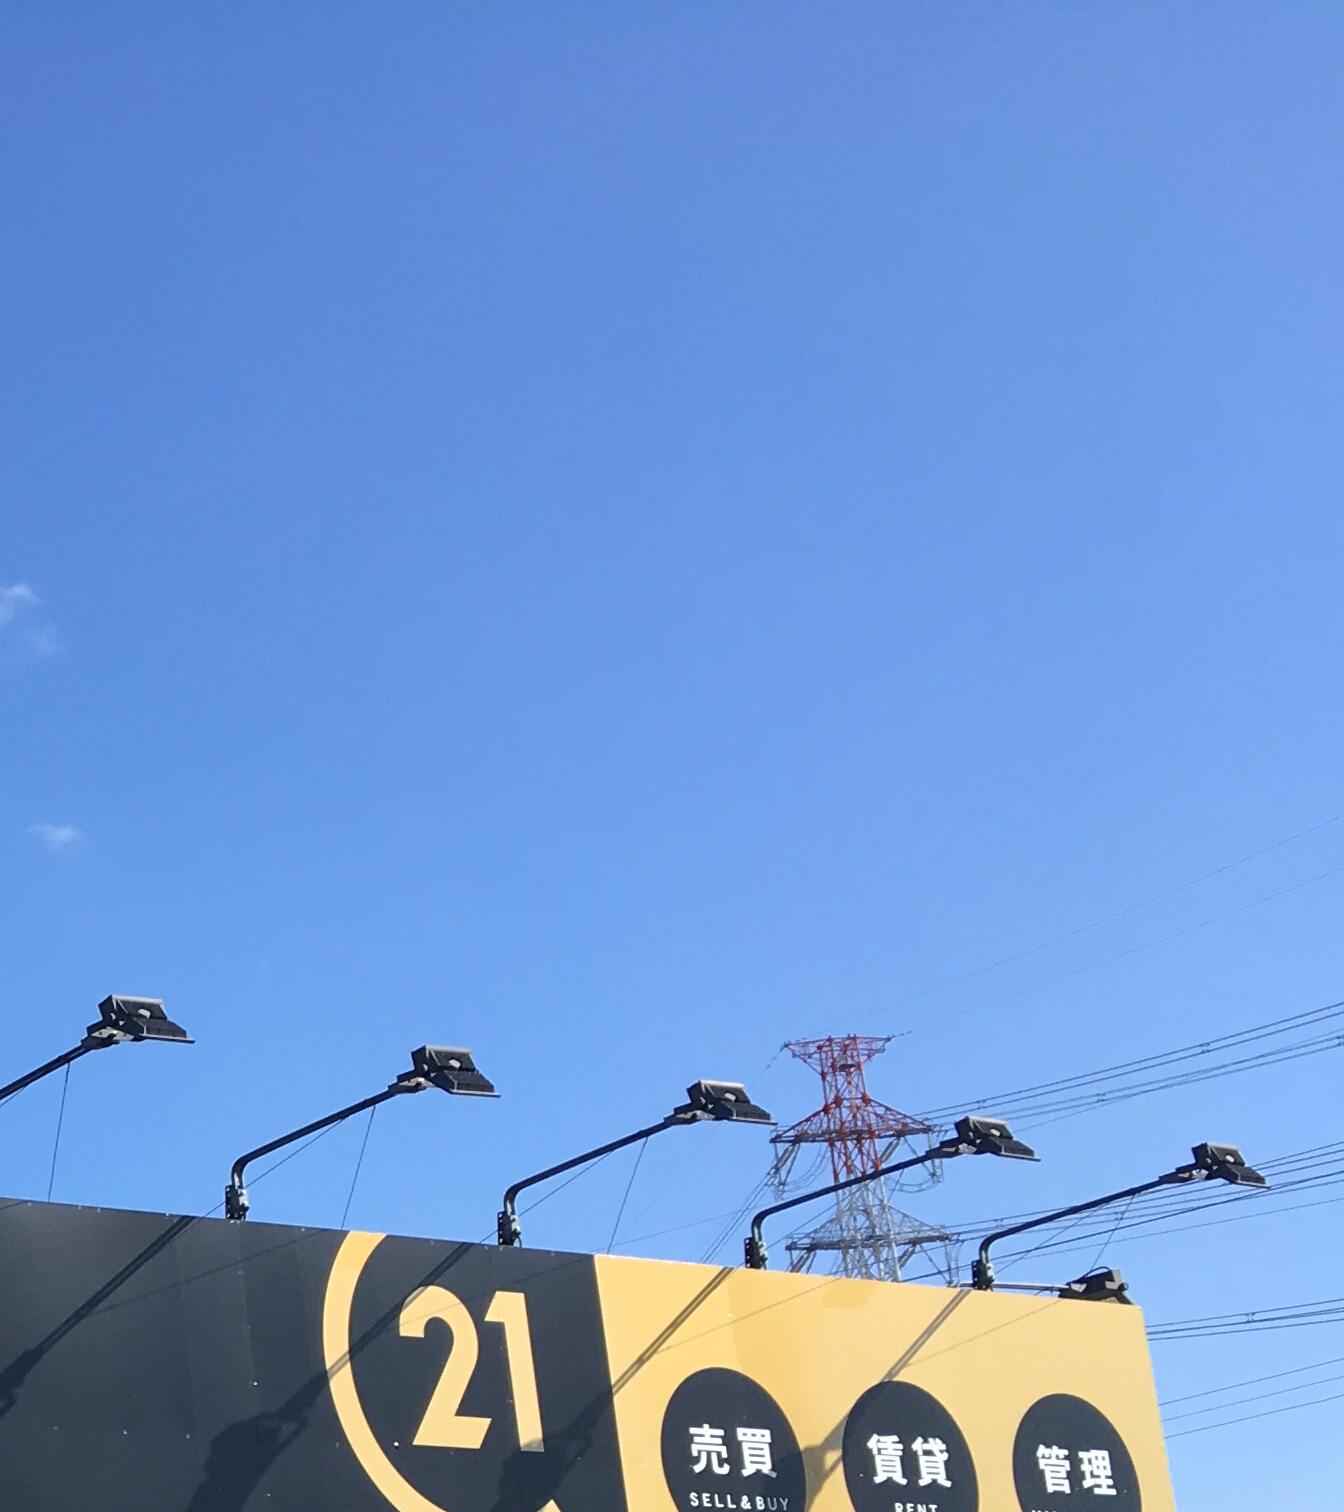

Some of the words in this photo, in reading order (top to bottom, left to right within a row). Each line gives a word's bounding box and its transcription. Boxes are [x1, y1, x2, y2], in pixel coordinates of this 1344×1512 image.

[689, 1424, 778, 1478] 売買
[867, 1433, 952, 1488] 賃貸
[1036, 1444, 1117, 1496] 管理
